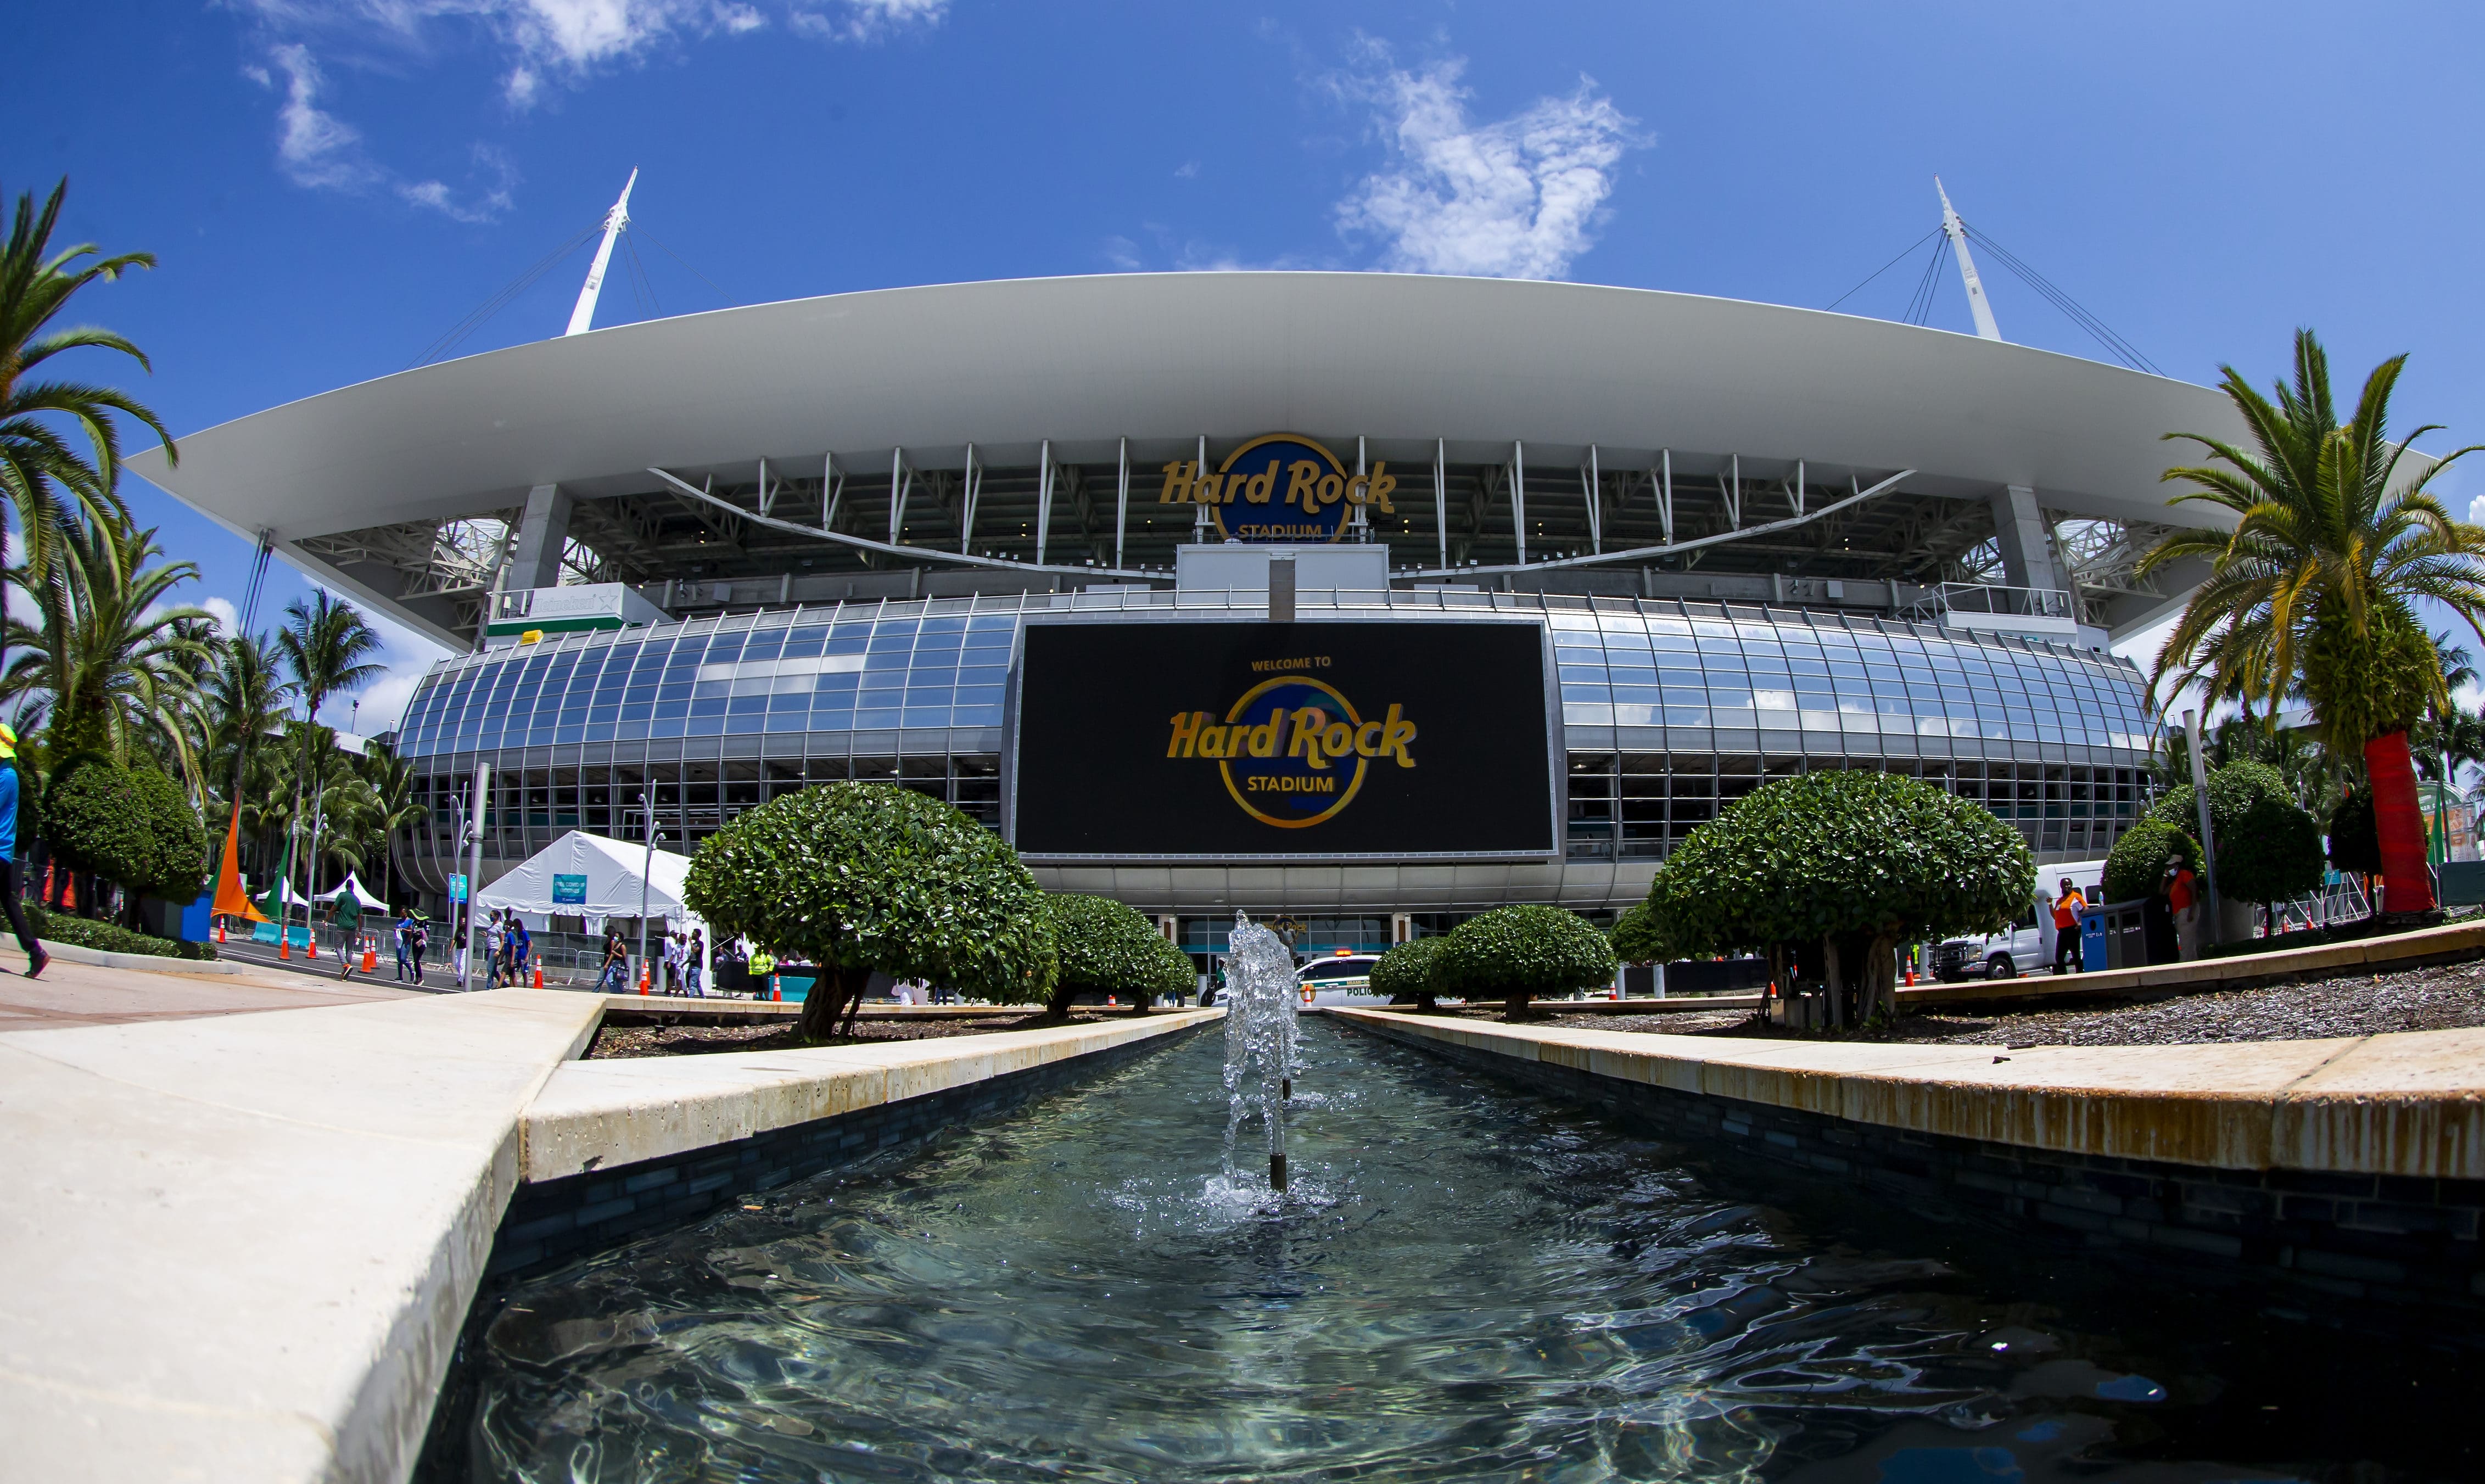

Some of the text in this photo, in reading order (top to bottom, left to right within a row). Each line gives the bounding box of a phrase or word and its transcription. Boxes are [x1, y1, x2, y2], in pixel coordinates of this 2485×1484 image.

[1159, 460, 1397, 513] Hard Rock
[1239, 524, 1322, 539] STADIUM
[532, 596, 594, 613] Heineken
[1251, 656, 1331, 671] WELCOME TO
[1167, 703, 1417, 769] Hard Rock
[1247, 776, 1334, 792] STADIUM
[1347, 987, 1373, 996] POLIC
